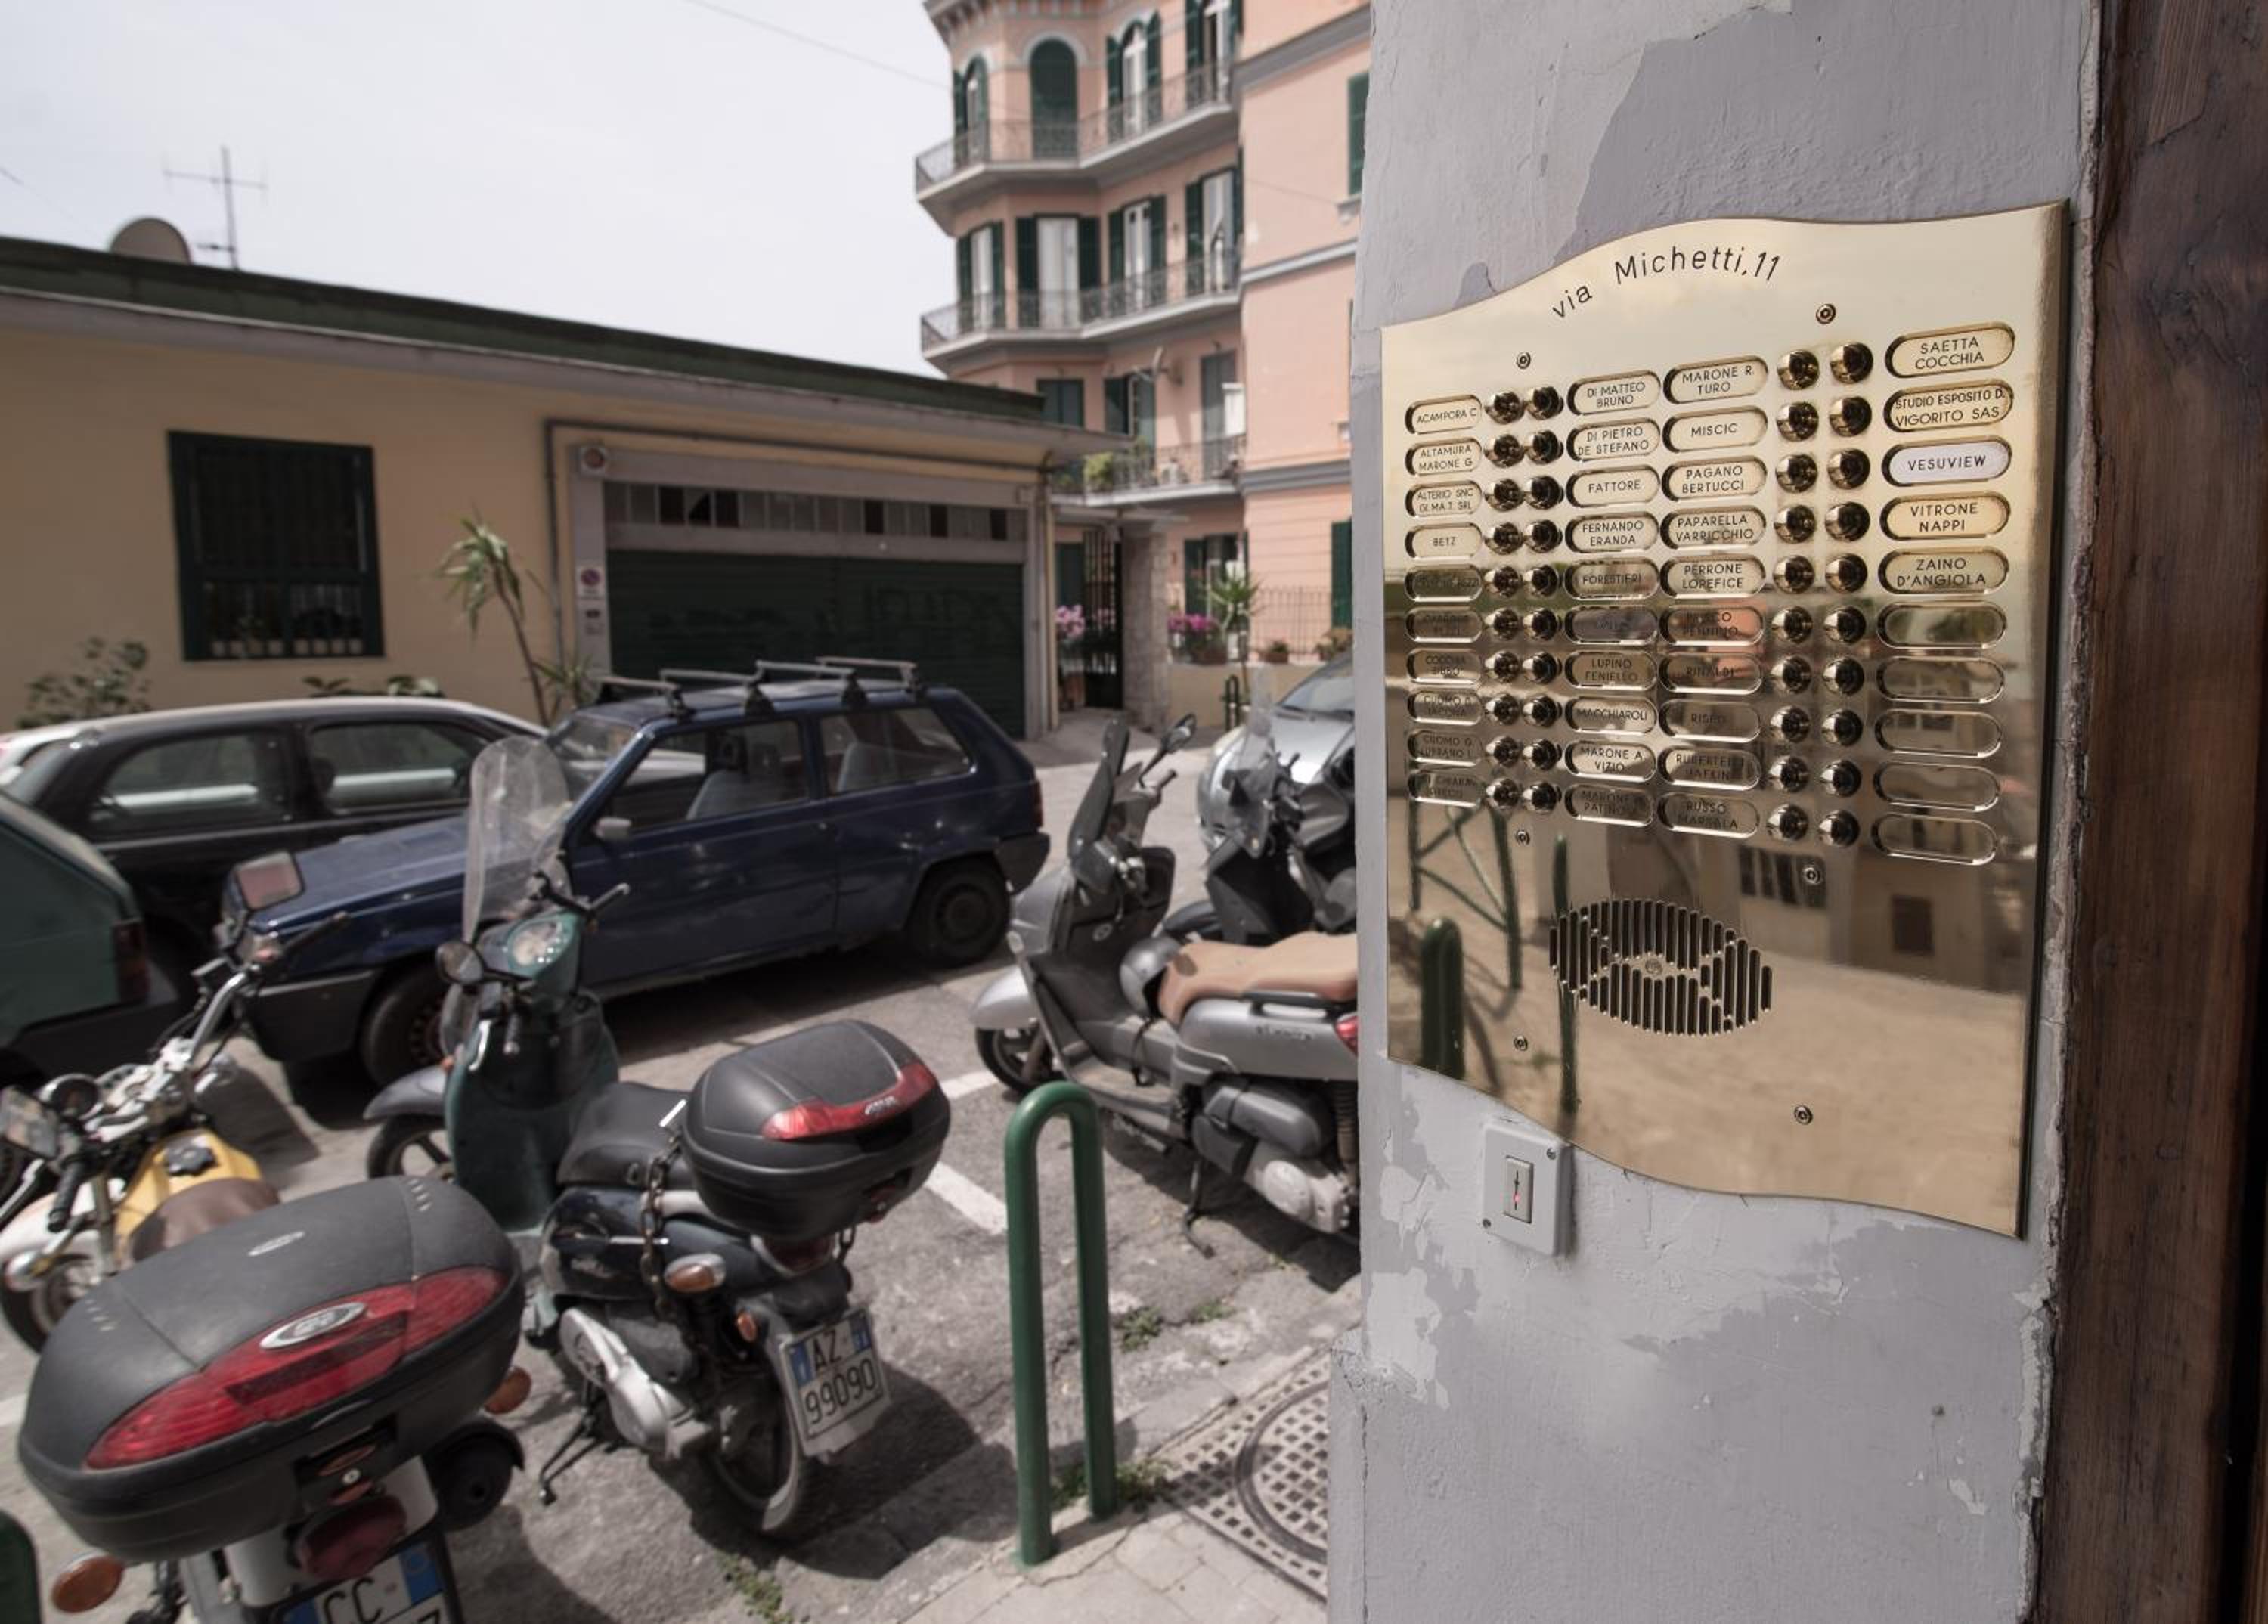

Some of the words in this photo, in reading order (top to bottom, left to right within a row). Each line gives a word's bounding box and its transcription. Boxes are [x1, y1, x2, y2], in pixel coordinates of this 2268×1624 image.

[1552, 285, 1593, 318] via
[1920, 336, 1979, 355] SAETTA
[1915, 352, 1984, 370] COCCHIA
[1682, 366, 1738, 384] MARONE
[1600, 381, 1646, 395] MATTEO
[1697, 381, 1730, 395] TURO
[1596, 394, 1634, 408] BRUNO
[1895, 395, 1935, 410] STUDIO
[1938, 389, 1991, 406] ESPOSITO
[1417, 409, 1467, 424] ACAMPORA
[1895, 409, 1963, 427] VIGORITO
[1972, 406, 2000, 420] SAS
[1587, 432, 1597, 442] DI
[1602, 426, 1643, 440] PIETRO
[1690, 423, 1737, 438] MISCIC
[1421, 445, 1472, 458] ALTAMURA
[1578, 445, 1591, 456] DE
[1596, 439, 1649, 454] STEFANO
[1418, 459, 1460, 471] MARONE
[1907, 455, 1987, 472] VESUVIEW
[1686, 465, 1743, 480] PAGANO
[1588, 479, 1641, 494] FATTORE
[1682, 479, 1744, 494] BERTUCCI
[1910, 501, 1979, 517] VITRONE
[1582, 519, 1644, 533] FERNANDO
[1678, 514, 1748, 528] PAPARELLA
[1919, 519, 1966, 533] NAPPI
[1590, 535, 1637, 547] ERANDA
[1676, 528, 1755, 542] VARRICCHIO
[1684, 563, 1743, 575] PERRONE
[1915, 557, 1967, 572] ZAINO
[1582, 572, 1641, 585] FORESTIERI
[1682, 577, 1744, 590] LOREFICE
[1897, 573, 1986, 587] D'ANGIOLA
[1591, 659, 1632, 670] LUPINO
[1576, 708, 1648, 721] MACCHIAROLI
[1422, 734, 1461, 746] CUOMO
[1580, 747, 1630, 760] MARONE
[1634, 751, 1644, 761] A
[1594, 761, 1625, 772] VIZIO
[1686, 800, 1727, 814] RUSSO
[813, 1328, 841, 1372] AZ
[805, 1358, 877, 1424] 99090
